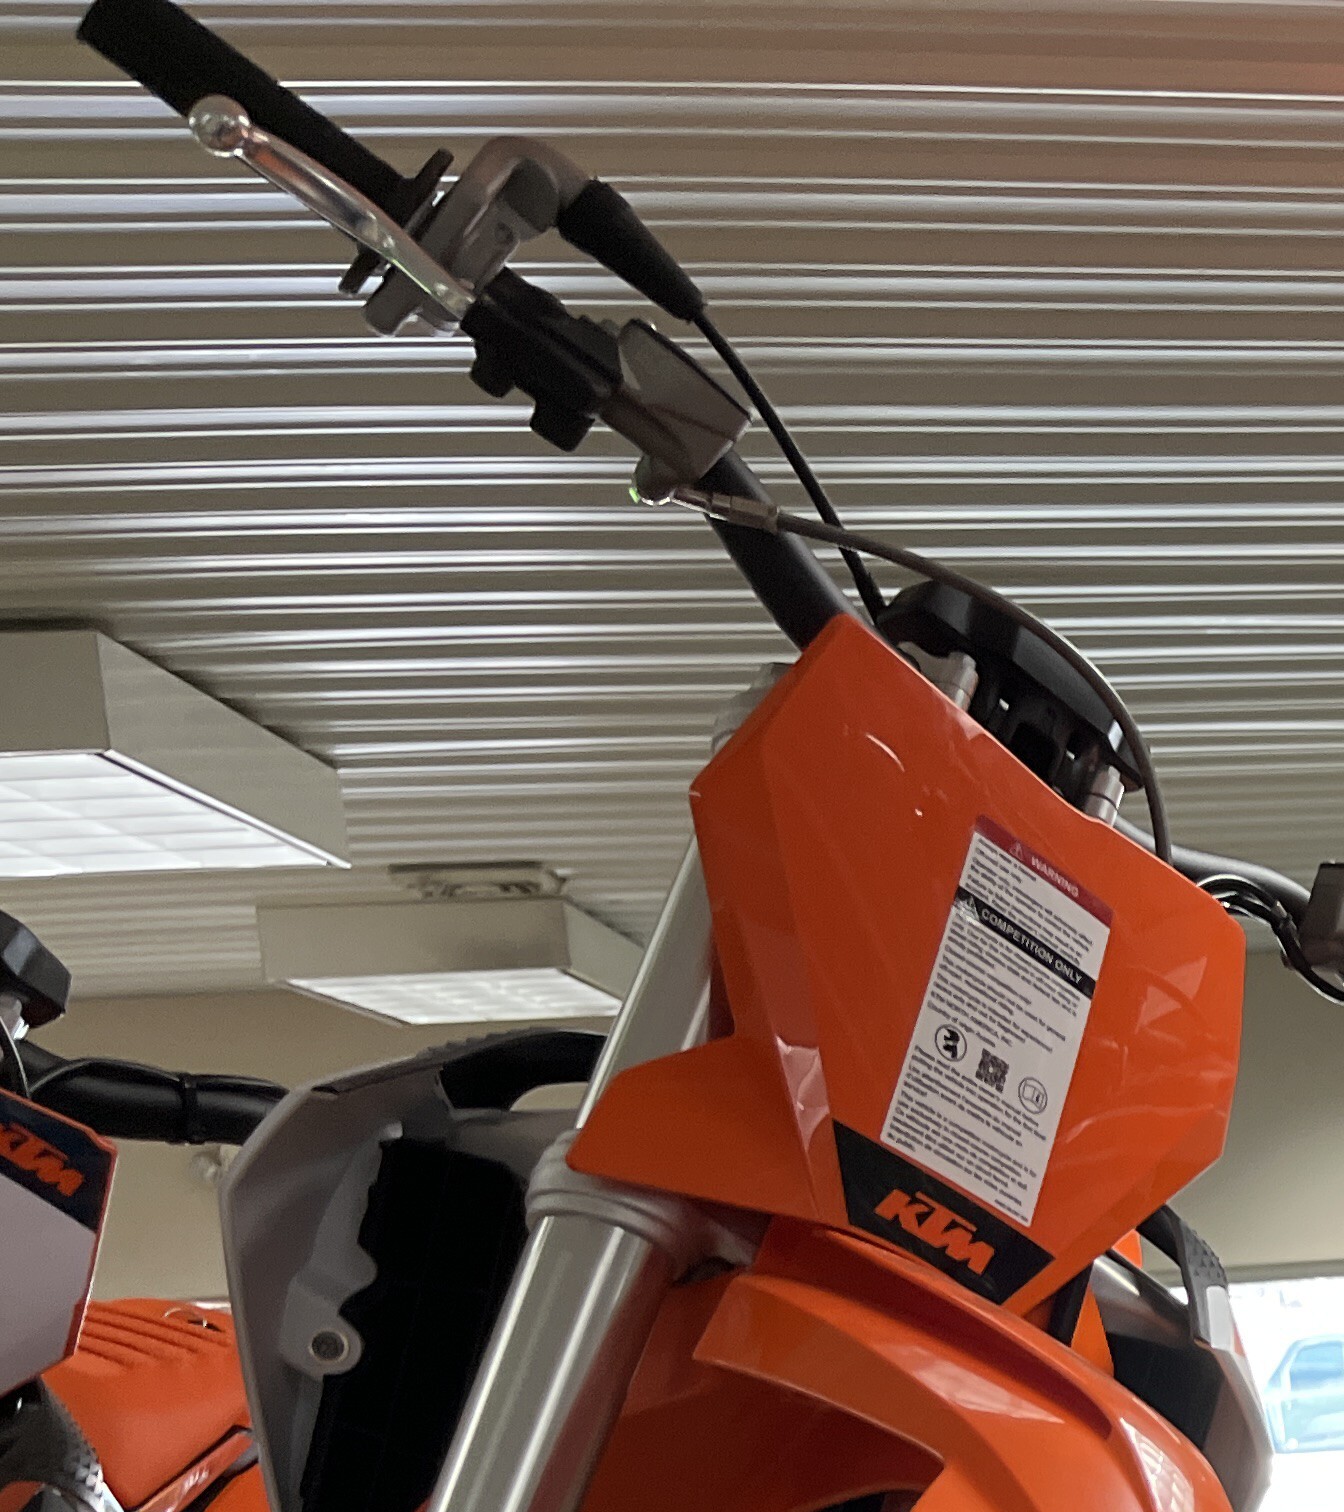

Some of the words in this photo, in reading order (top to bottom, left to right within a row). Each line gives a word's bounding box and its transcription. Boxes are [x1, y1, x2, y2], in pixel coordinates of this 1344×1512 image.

[1031, 856, 1079, 898] WARNING
[981, 908, 1054, 964] COMPETITION
[1055, 957, 1083, 984] ONLY
[874, 1188, 995, 1276] KTM
